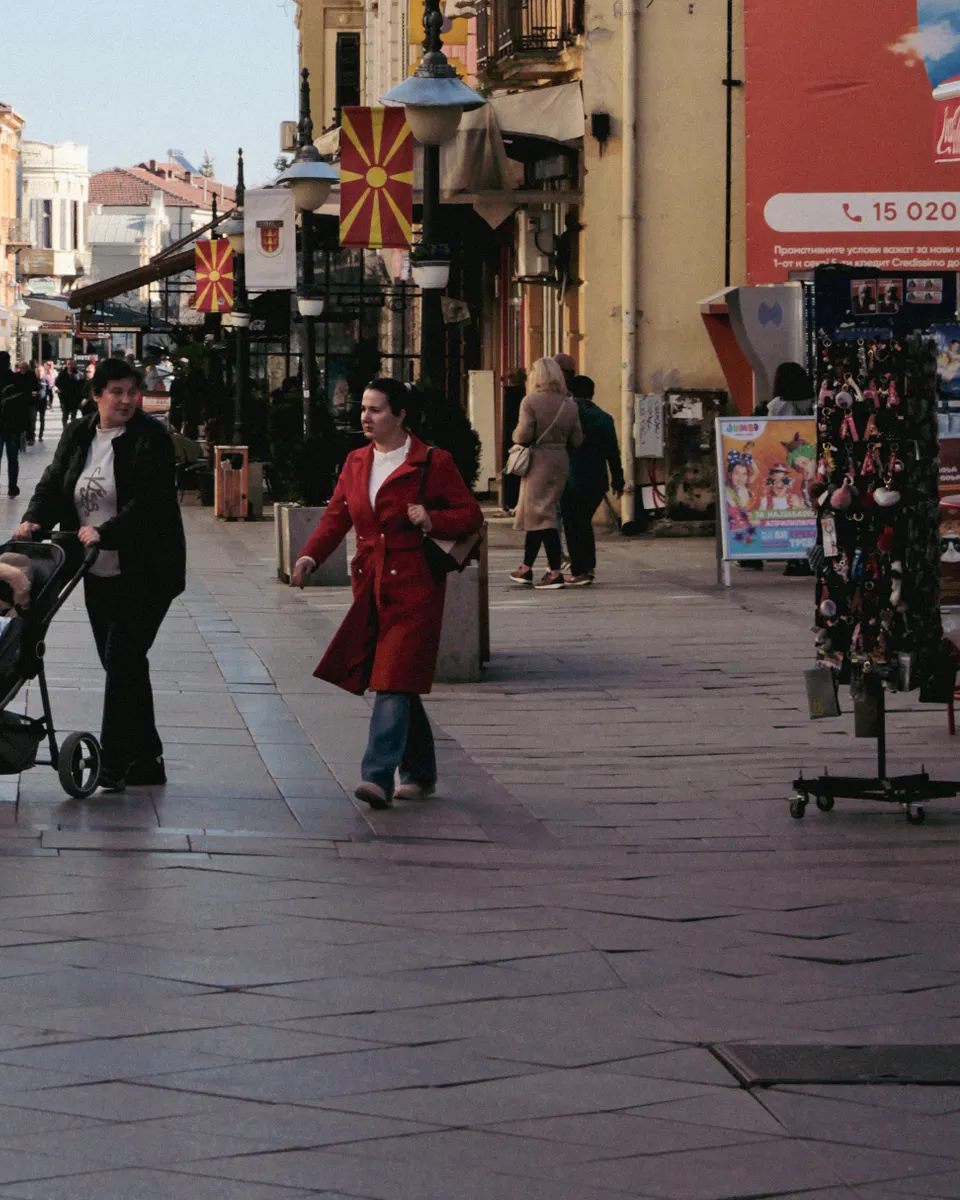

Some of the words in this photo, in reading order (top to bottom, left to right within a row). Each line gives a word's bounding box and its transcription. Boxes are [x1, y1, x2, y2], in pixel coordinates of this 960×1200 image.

[873, 202, 897, 221] 15
[906, 201, 957, 221] 020
[892, 257, 946, 267] Credissimo
